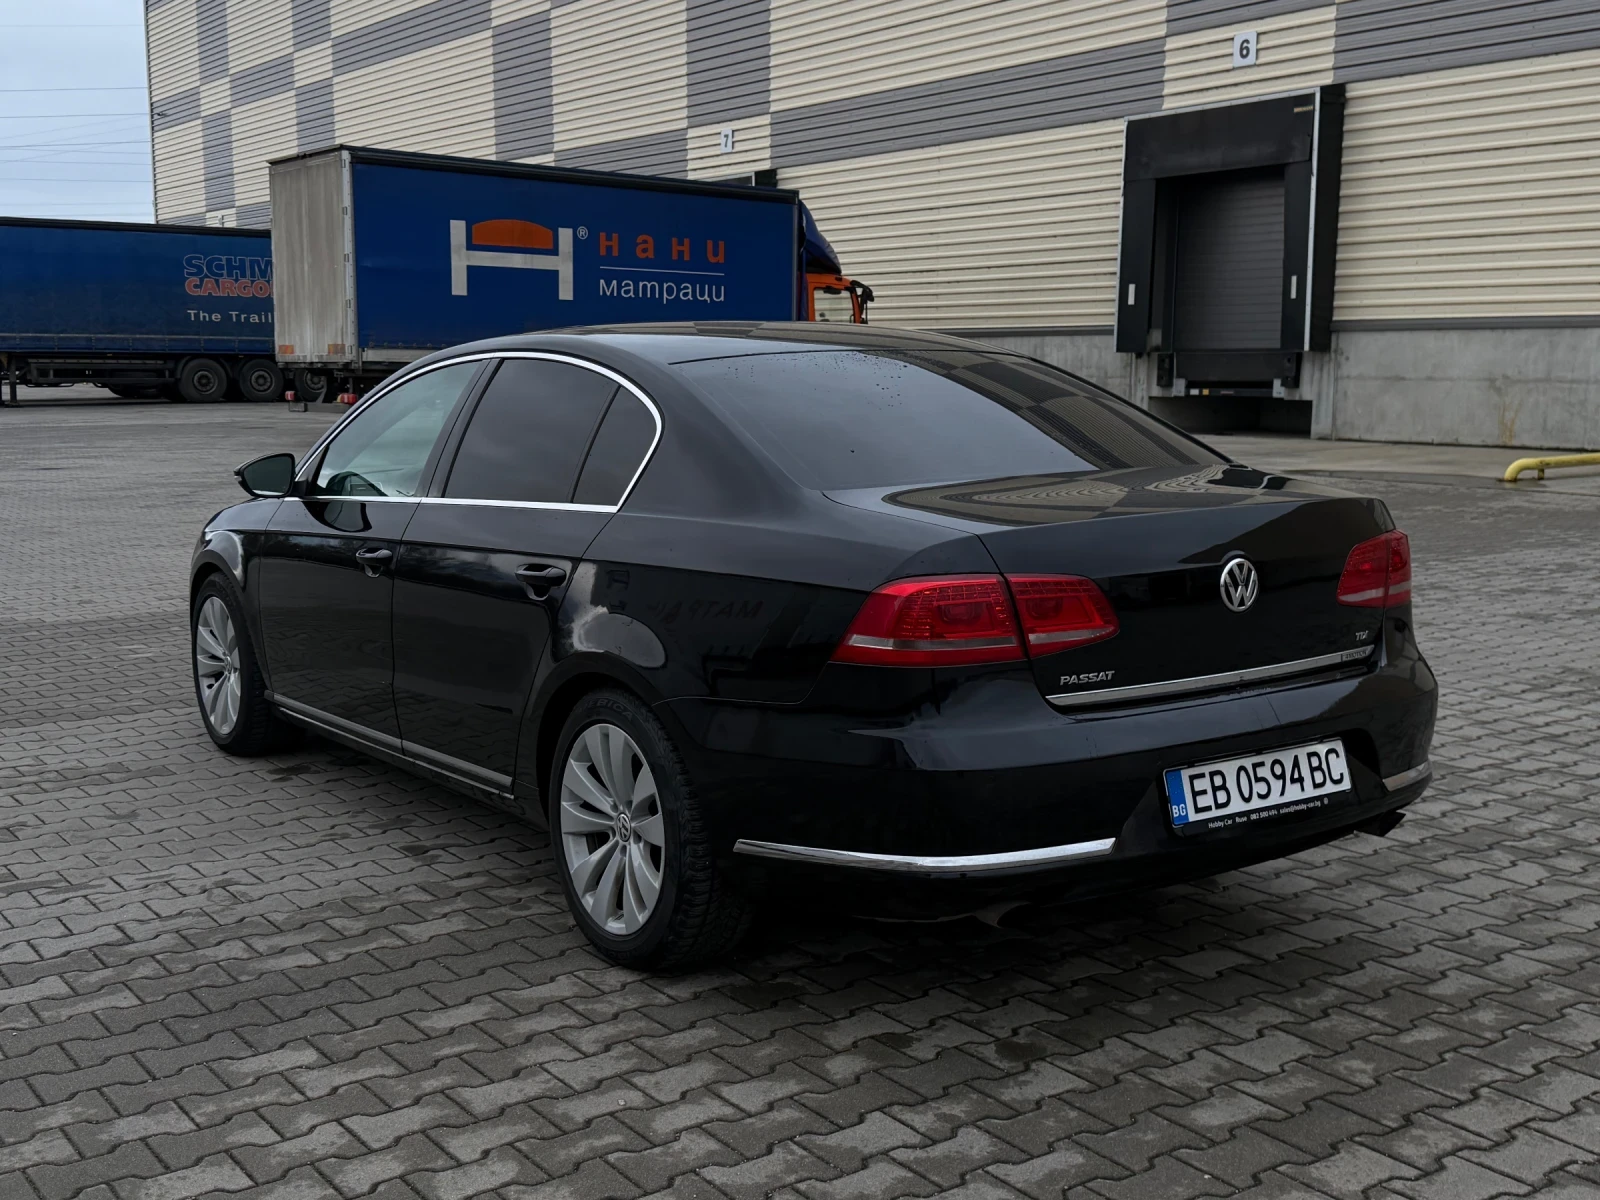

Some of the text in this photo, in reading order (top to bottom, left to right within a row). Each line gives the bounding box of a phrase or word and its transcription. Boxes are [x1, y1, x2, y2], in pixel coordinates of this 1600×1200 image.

[1239, 38, 1251, 60] 6
[723, 133, 730, 148] 7
[185, 277, 274, 298] CARGO
[187, 310, 221, 322] The
[1060, 670, 1115, 686] PASSAT
[1188, 747, 1345, 814] EB 0594 BC
[1172, 804, 1187, 818] BG
[1208, 819, 1224, 829] Hobby
[1224, 818, 1233, 826] Car
